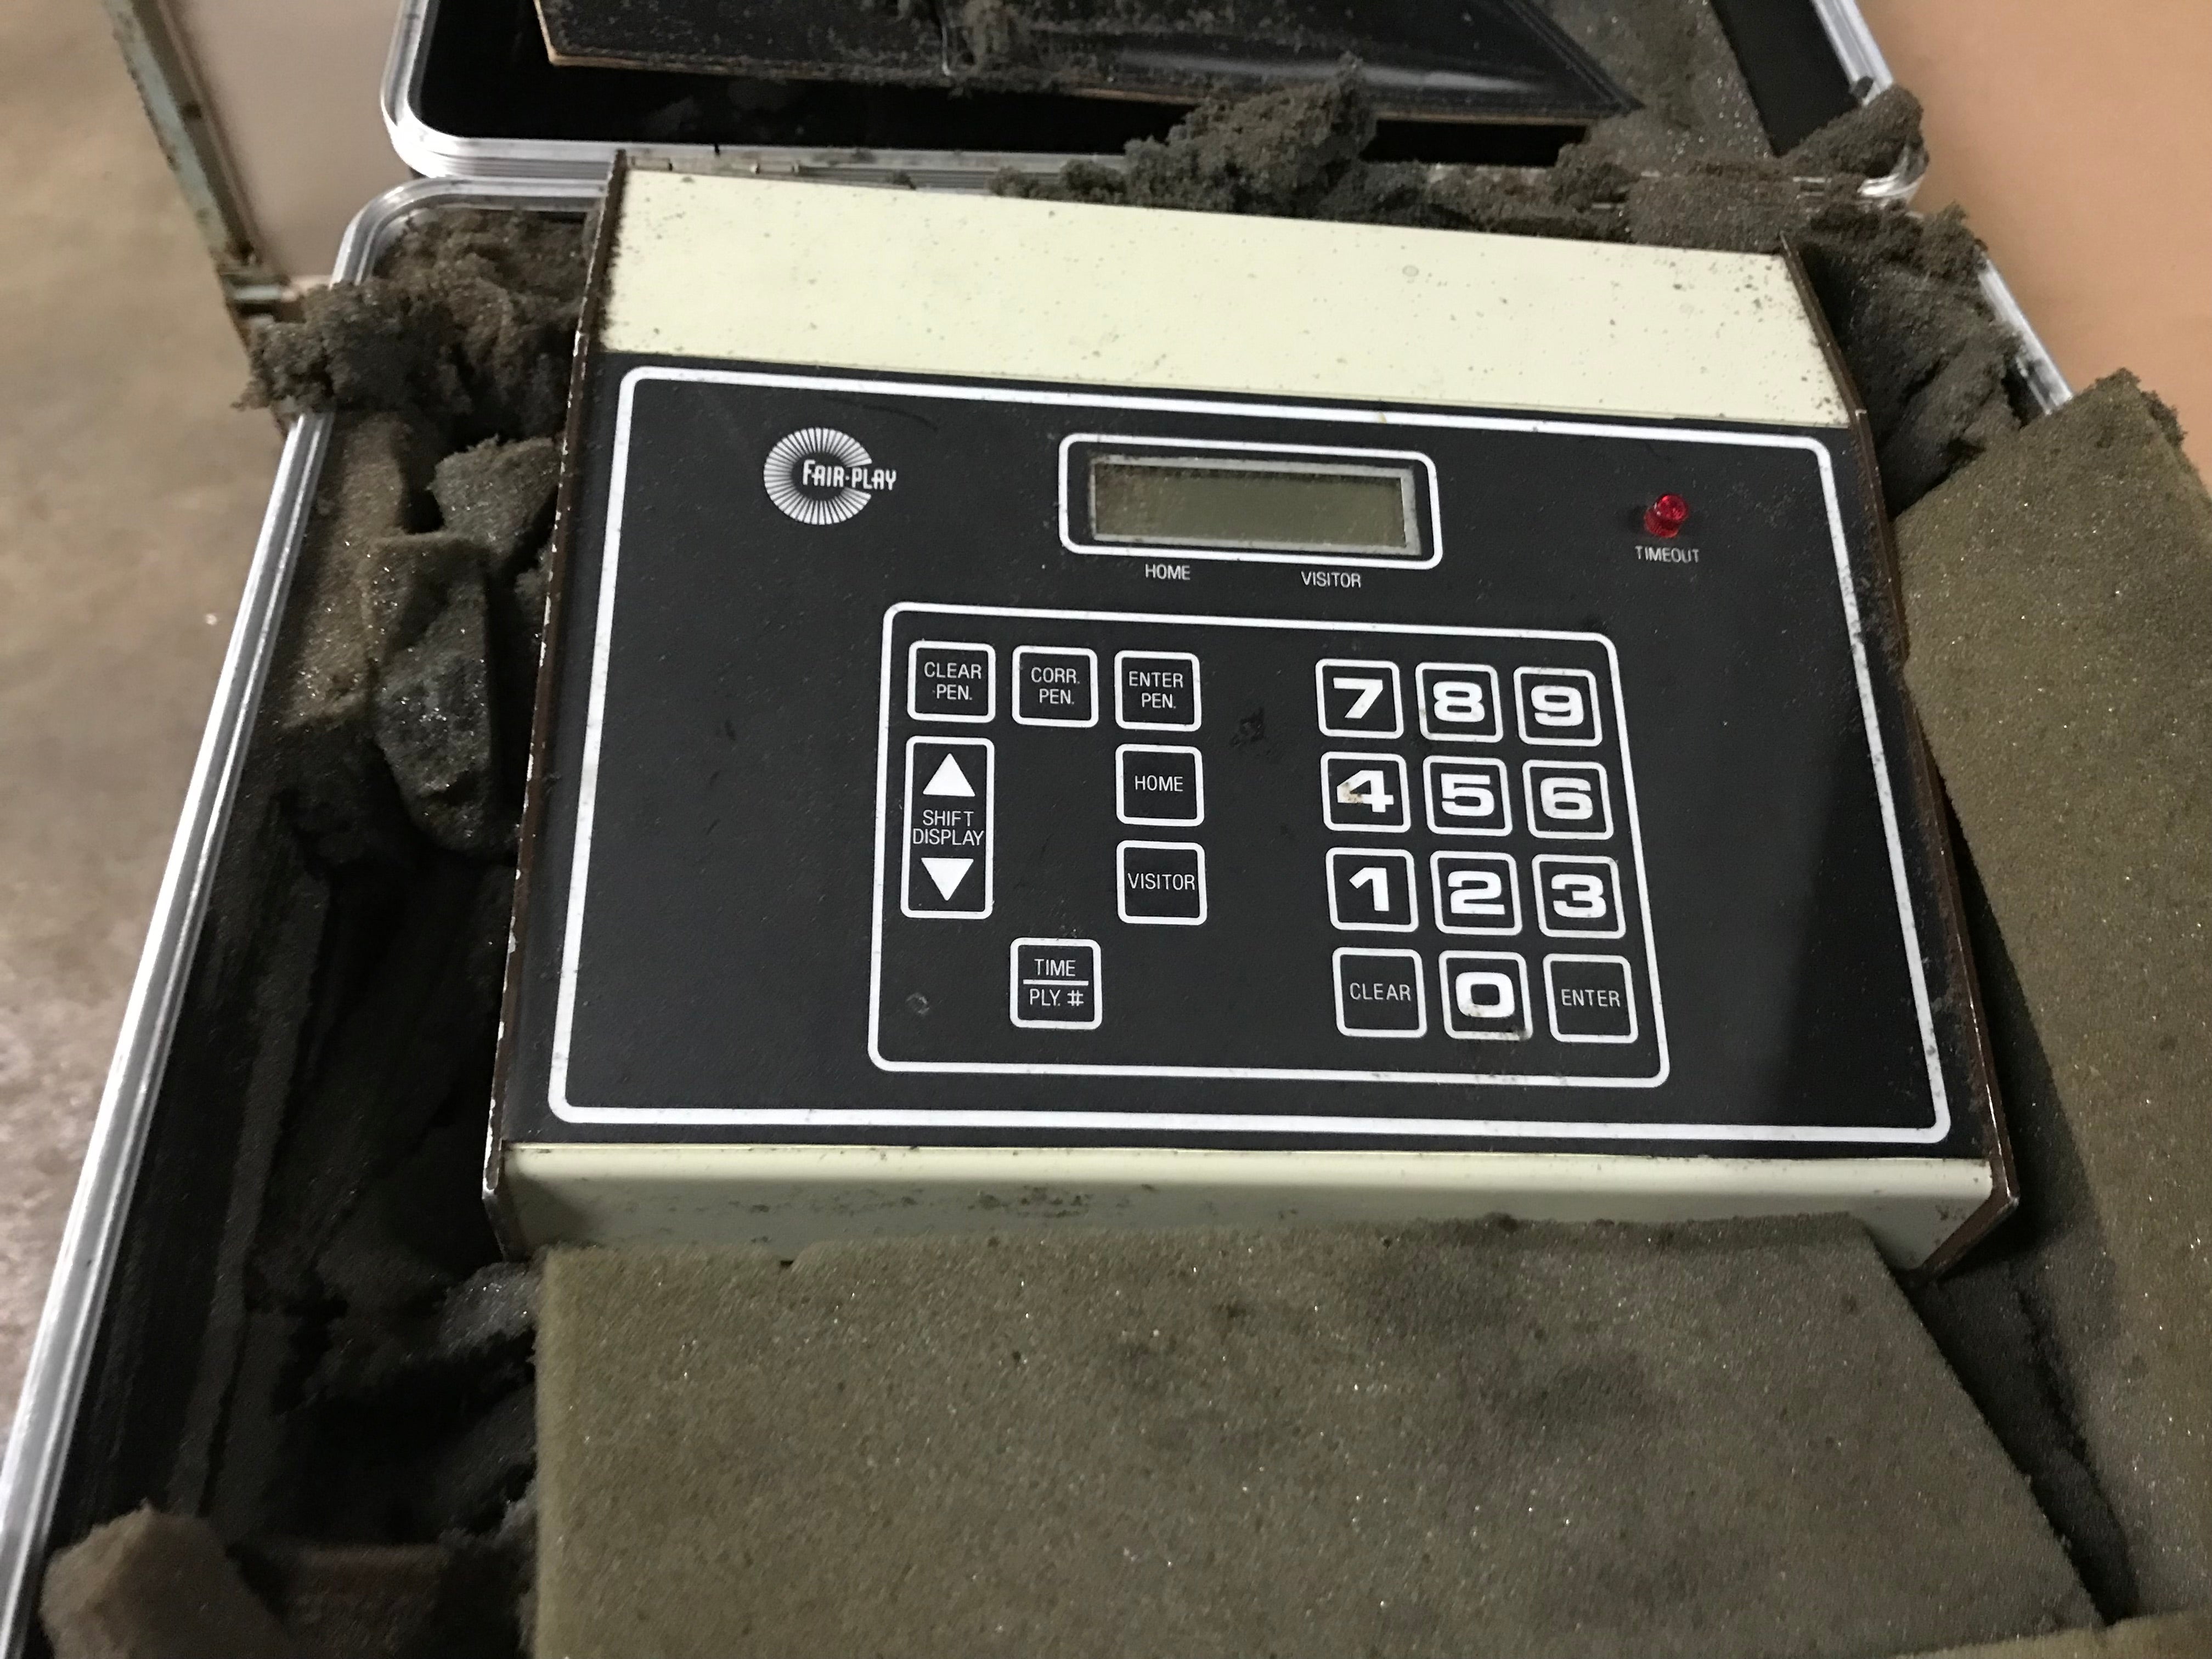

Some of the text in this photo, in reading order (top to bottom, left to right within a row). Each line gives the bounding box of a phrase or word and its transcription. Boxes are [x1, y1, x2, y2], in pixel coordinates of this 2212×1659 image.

[1635, 545, 1699, 563] TIMEOUT
[1145, 563, 1190, 580] HOME
[1301, 571, 1361, 588] VISITOR
[924, 661, 982, 679] CLEAR
[1031, 667, 1080, 684] CORR.
[1128, 670, 1183, 688] ENTER
[936, 684, 973, 701] PEN.
[1039, 688, 1075, 704] PEN.
[1141, 692, 1176, 709] PEN.
[1333, 677, 1384, 719] 7
[1433, 681, 1485, 723] 8
[1531, 685, 1584, 726] 9
[1135, 775, 1183, 792] HOME
[1336, 770, 1394, 813] 4
[1441, 773, 1494, 817] 5
[1540, 777, 1593, 820] 6
[922, 809, 974, 827] SHIFT
[912, 828, 984, 846] DISPLAY
[1127, 872, 1195, 890] VISITOR
[1349, 867, 1390, 912] 1
[1448, 871, 1505, 915] 2
[1551, 873, 1607, 918] 3
[1034, 958, 1076, 977] TIME
[1029, 988, 1084, 1007] PLY. #
[1350, 983, 1411, 1001] CLEAR
[1455, 972, 1515, 1018] 0
[1561, 989, 1621, 1007] ENTER
